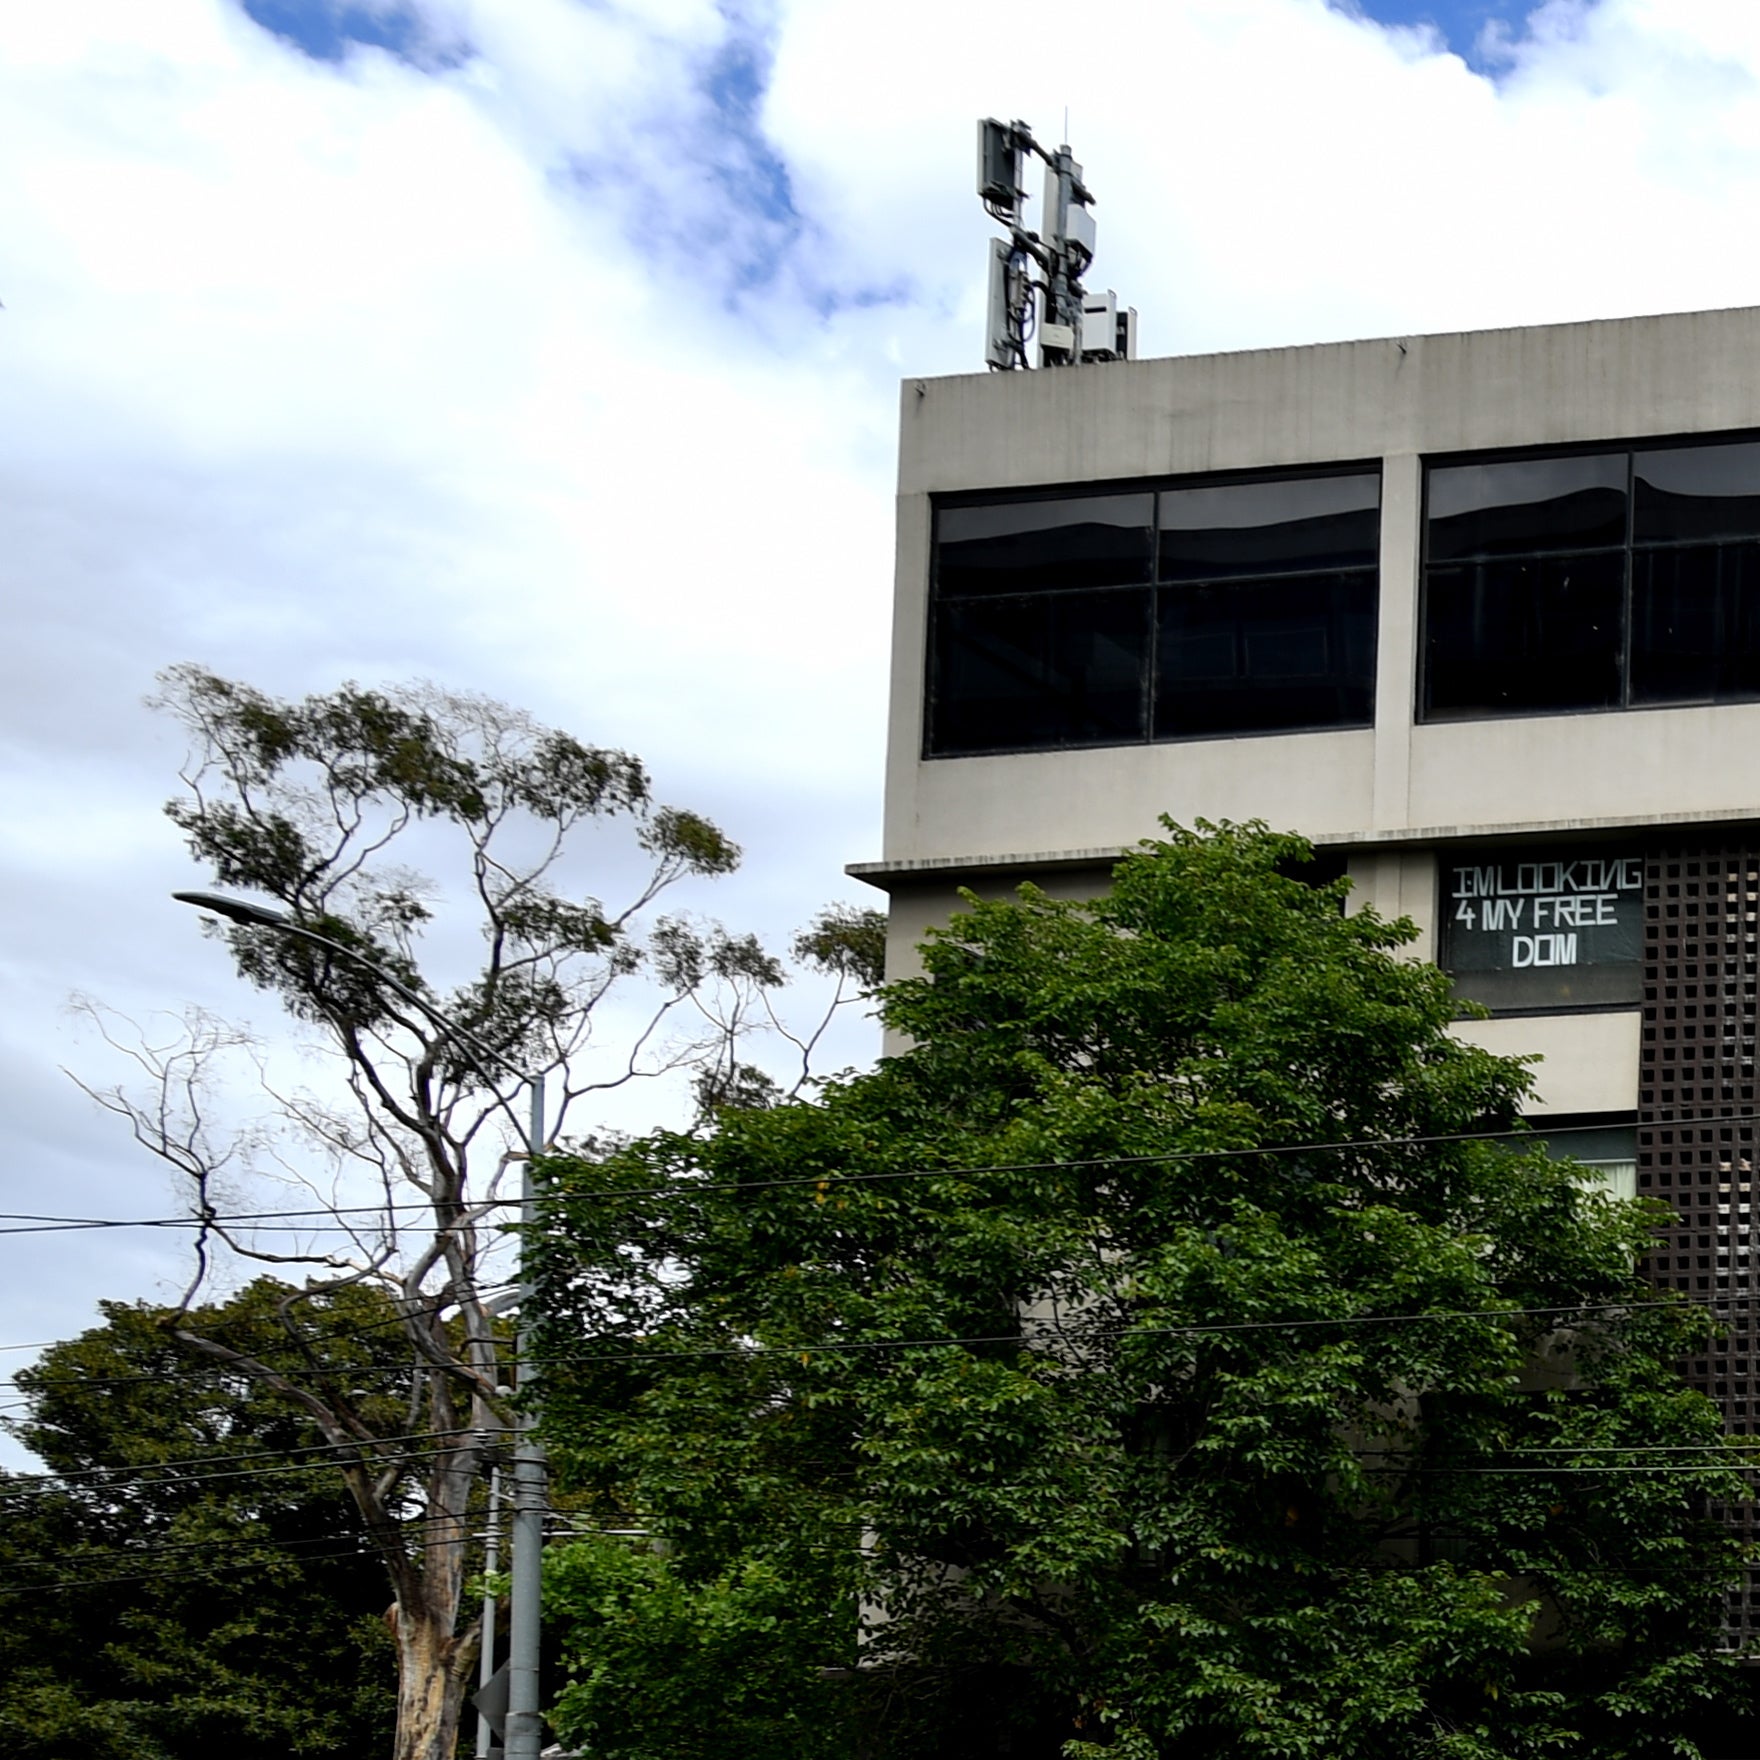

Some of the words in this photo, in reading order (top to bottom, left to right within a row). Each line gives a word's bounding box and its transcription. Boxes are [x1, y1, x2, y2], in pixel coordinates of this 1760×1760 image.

[1497, 858, 1642, 894] LOOKING
[1455, 899, 1476, 930] 4
[1482, 898, 1525, 931] MY
[1534, 893, 1618, 929] FREE
[1512, 933, 1577, 967] DOM
